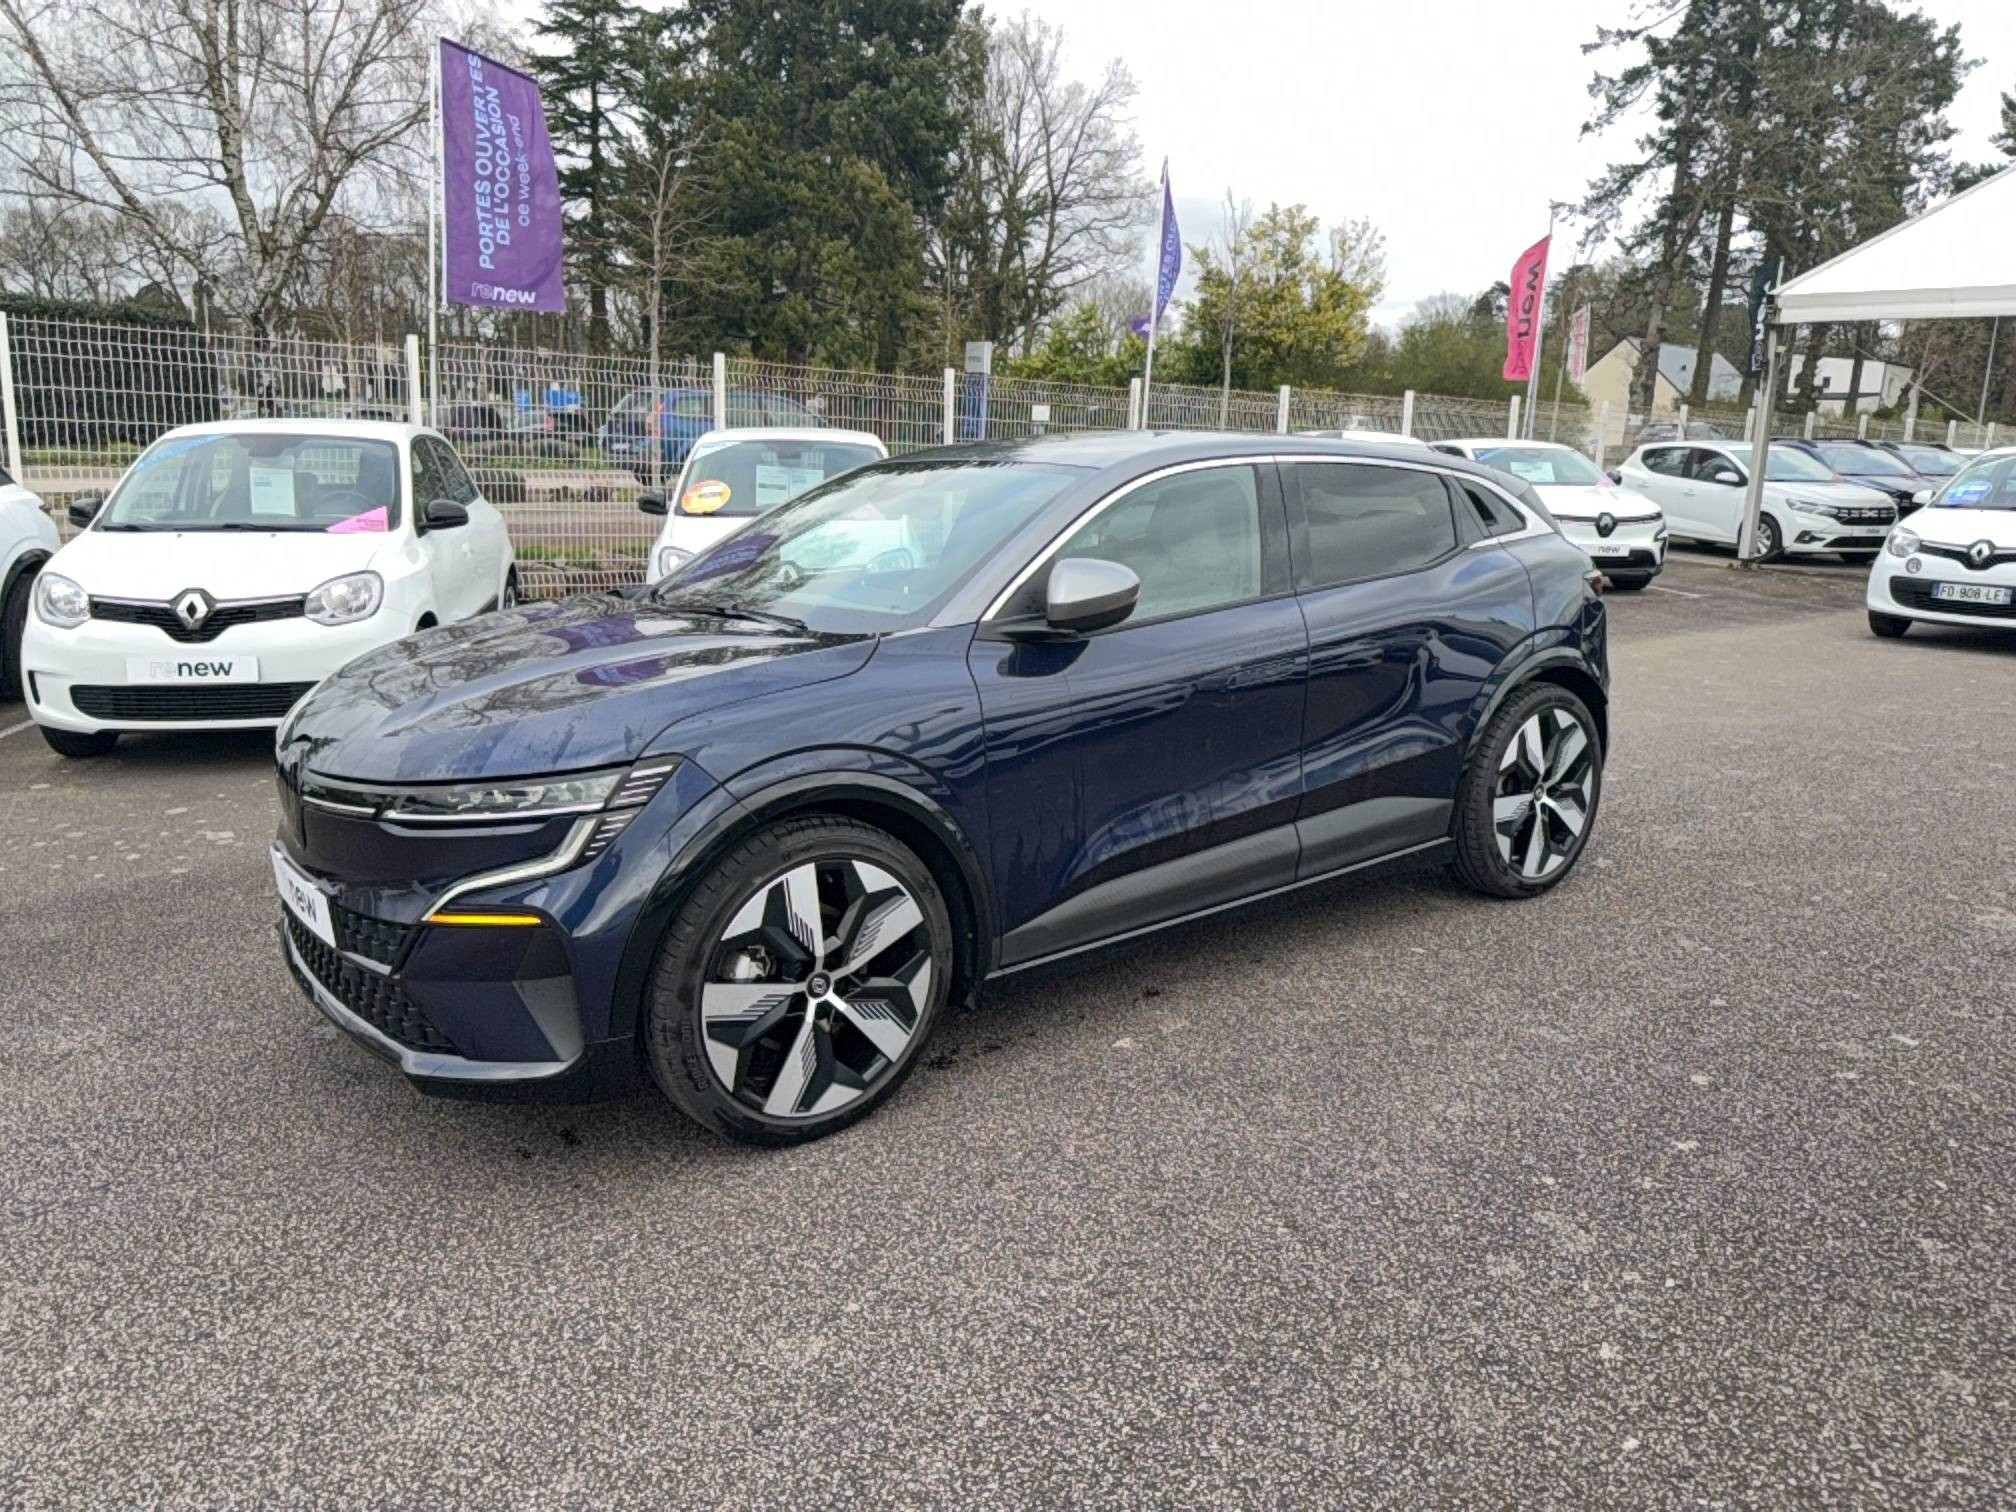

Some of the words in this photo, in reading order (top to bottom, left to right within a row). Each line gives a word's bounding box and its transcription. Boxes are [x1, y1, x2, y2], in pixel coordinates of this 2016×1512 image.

[468, 54, 493, 177] OUVERTES
[485, 86, 511, 213] L'OCCASION
[507, 114, 531, 200] week-end
[474, 180, 495, 270] PORTES
[496, 216, 510, 245] DE
[518, 203, 530, 227] ce
[471, 283, 536, 304] renew
